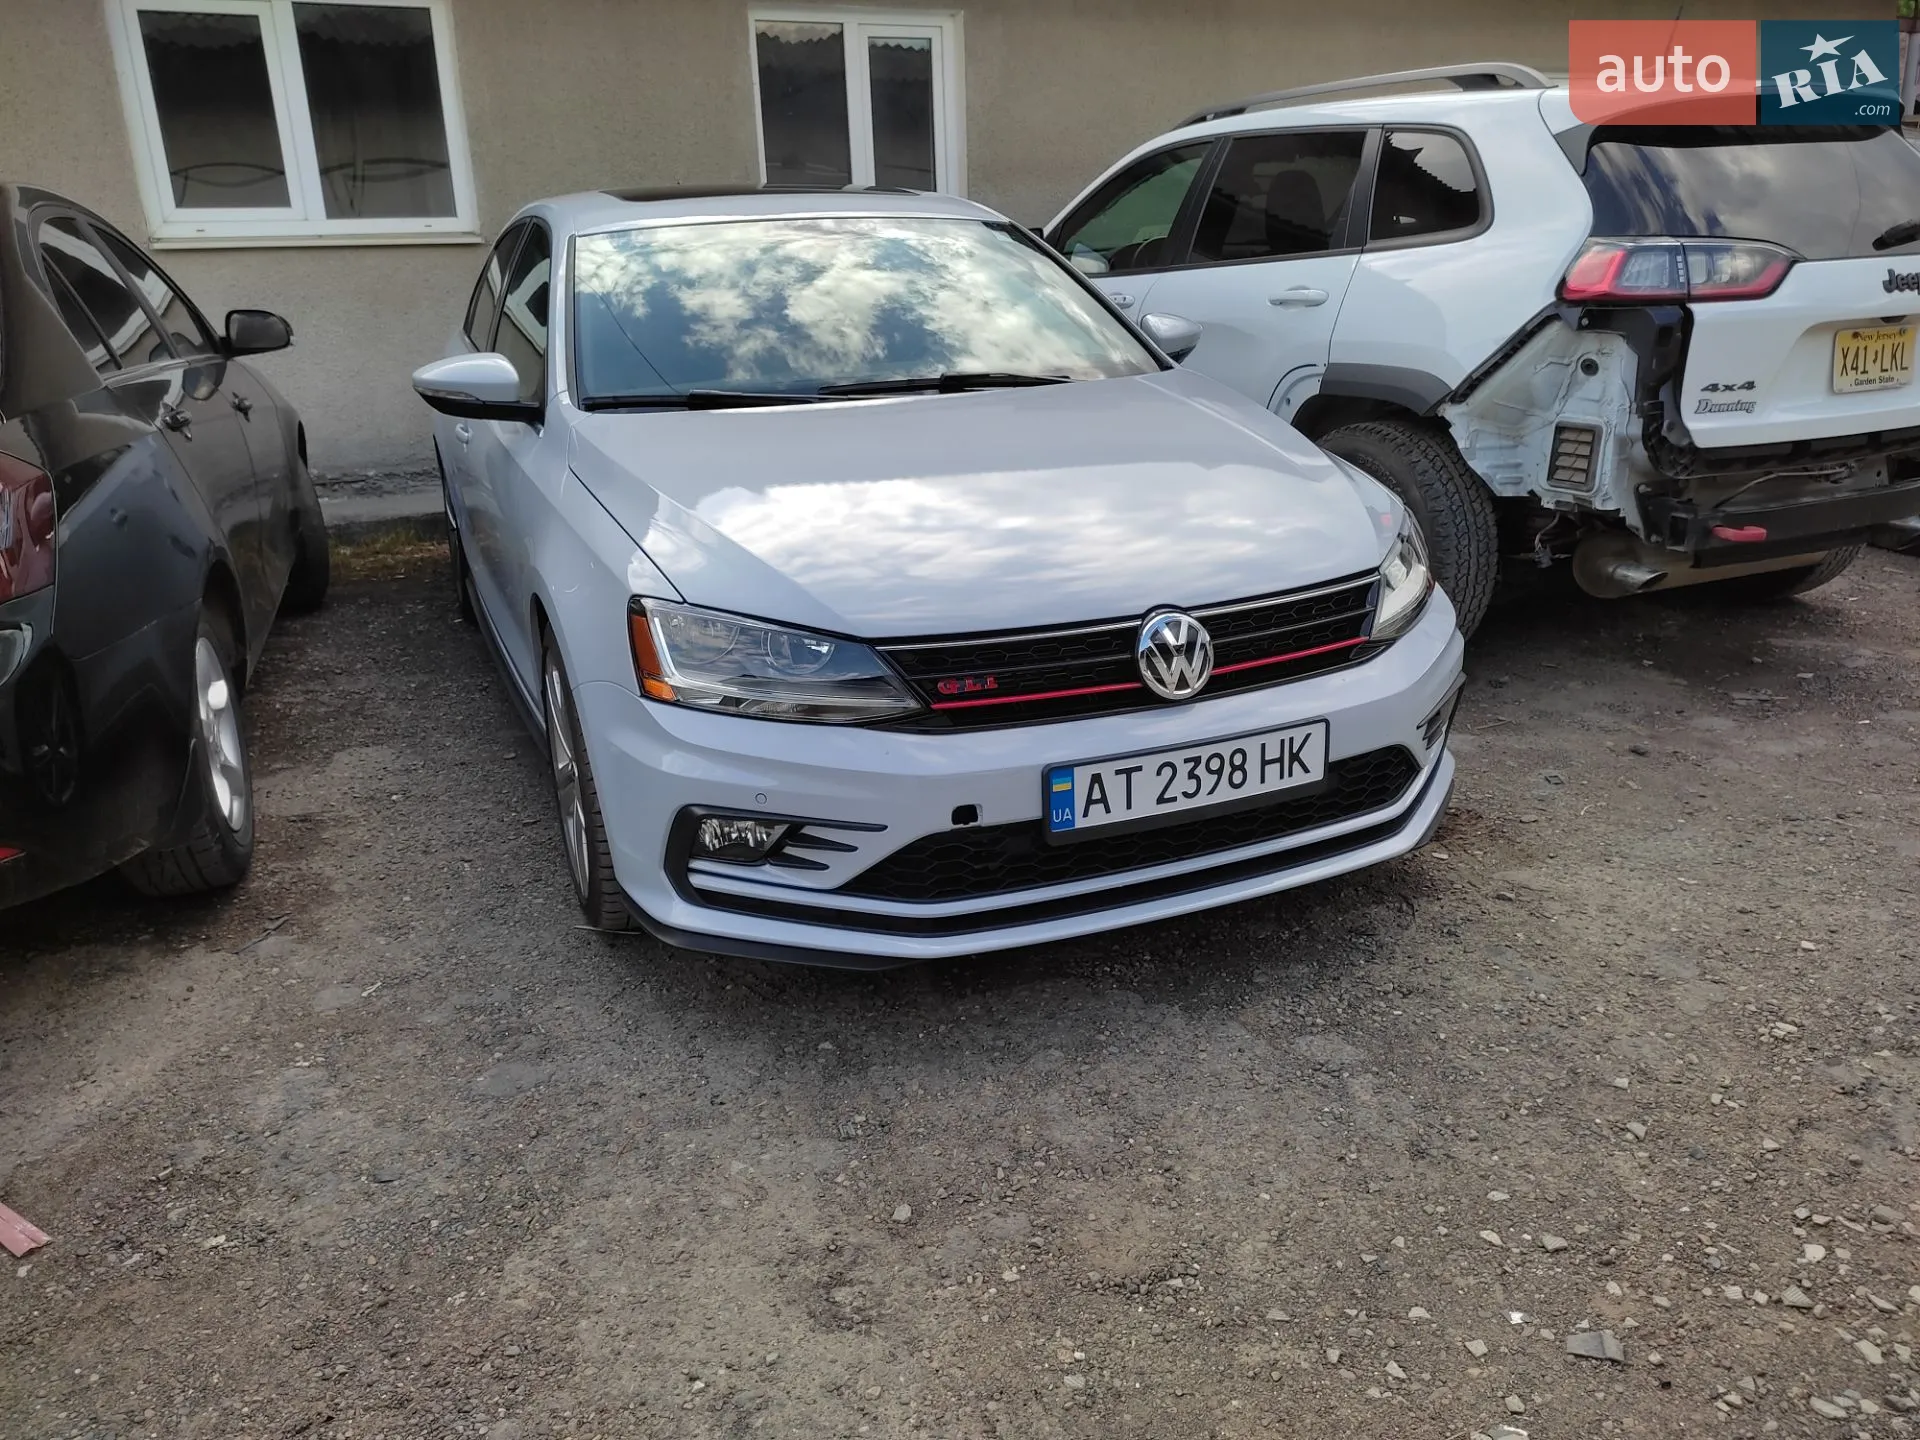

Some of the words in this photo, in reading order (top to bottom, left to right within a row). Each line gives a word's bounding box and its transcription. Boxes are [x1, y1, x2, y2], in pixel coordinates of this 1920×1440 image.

[1858, 331, 1873, 341] New
[1874, 330, 1897, 342] Jersey
[1840, 345, 1869, 377] X41
[1880, 341, 1909, 373] LKL
[1701, 380, 1756, 392] 4x4
[1854, 378, 1877, 387] Garden
[1878, 375, 1895, 385] State
[1082, 766, 1143, 818] AT
[1156, 748, 1248, 805] 2398
[1260, 732, 1312, 784] HK
[1053, 809, 1072, 823] UA
